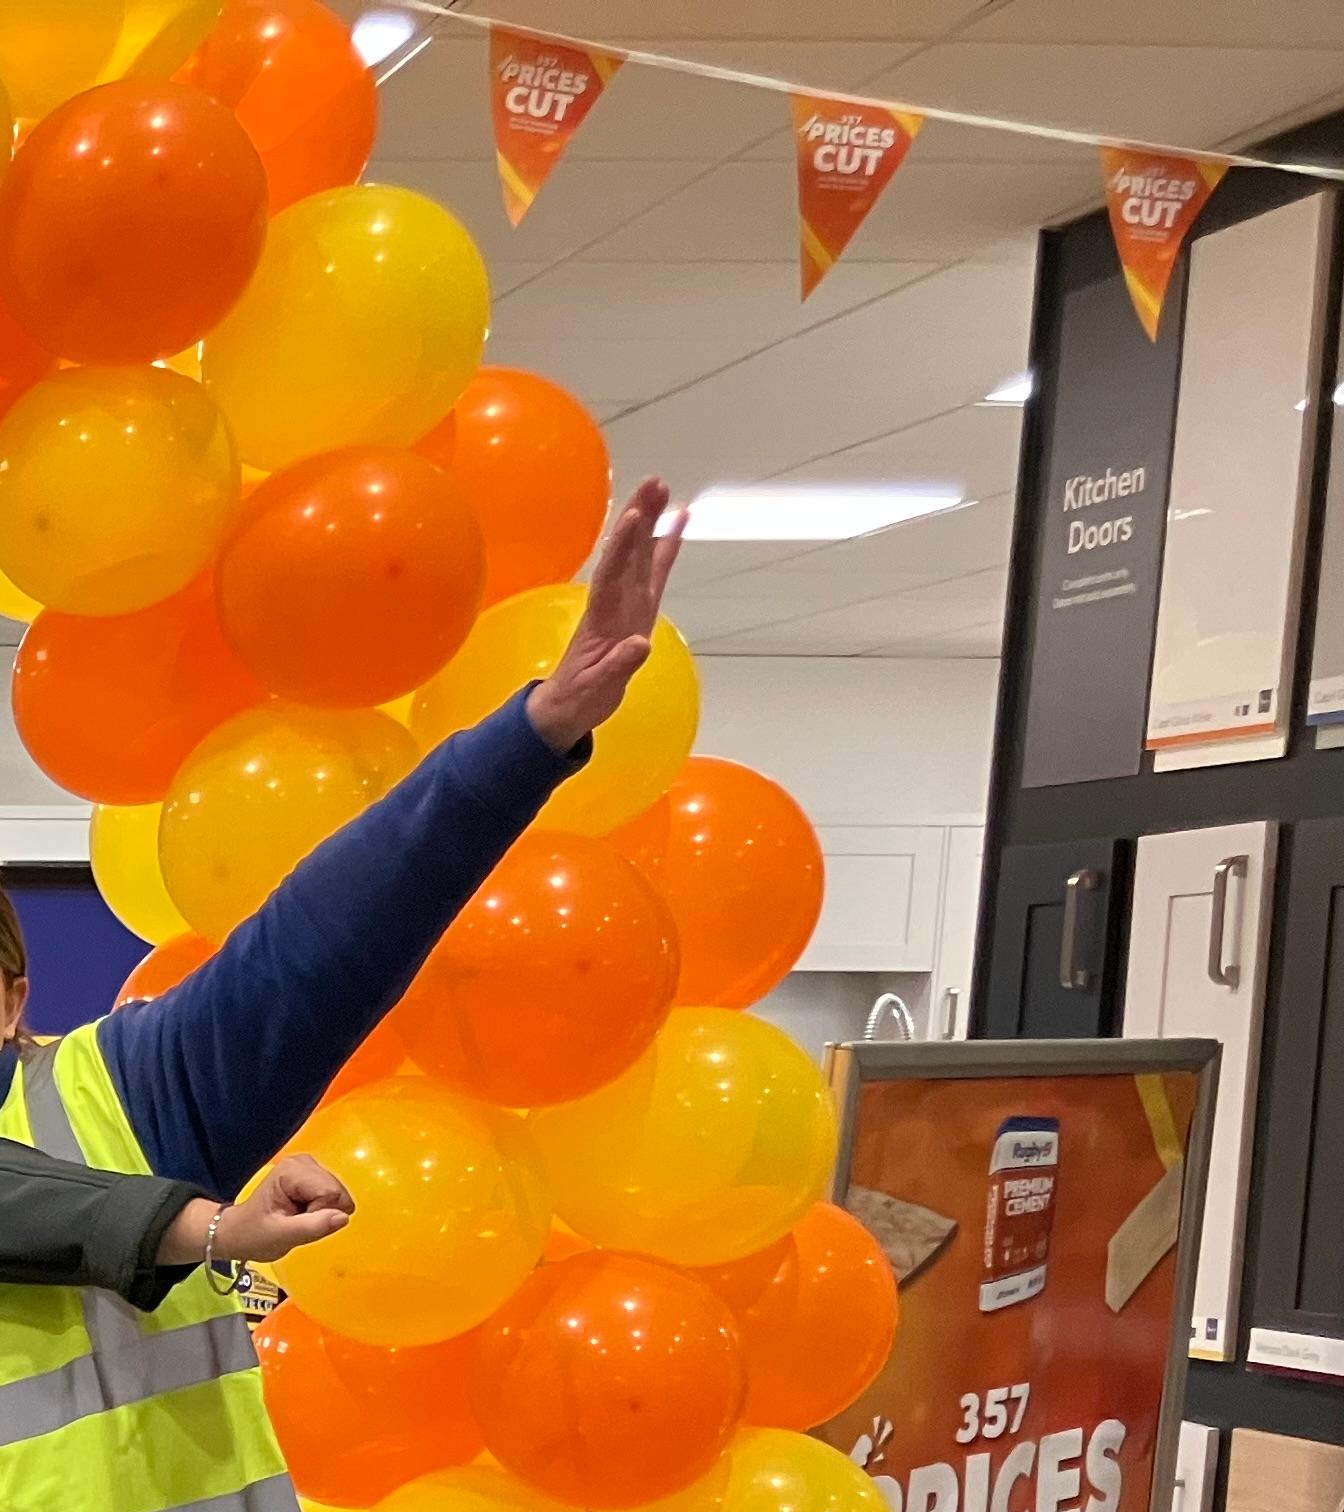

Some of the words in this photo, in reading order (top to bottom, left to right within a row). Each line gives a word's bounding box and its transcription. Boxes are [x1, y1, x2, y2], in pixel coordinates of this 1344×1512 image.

[501, 62, 589, 95] PRICES
[505, 86, 574, 121] CUT
[807, 122, 895, 149] PRICES
[813, 144, 884, 176] CUT
[1115, 175, 1196, 201] PRICES
[1122, 197, 1183, 228] CUT
[1063, 467, 1145, 512] Kitchen
[1067, 516, 1133, 554] Doors
[1004, 1177, 1054, 1198] PREMIUM
[1006, 1193, 1050, 1216] CEMENT
[955, 1382, 1030, 1444] 357
